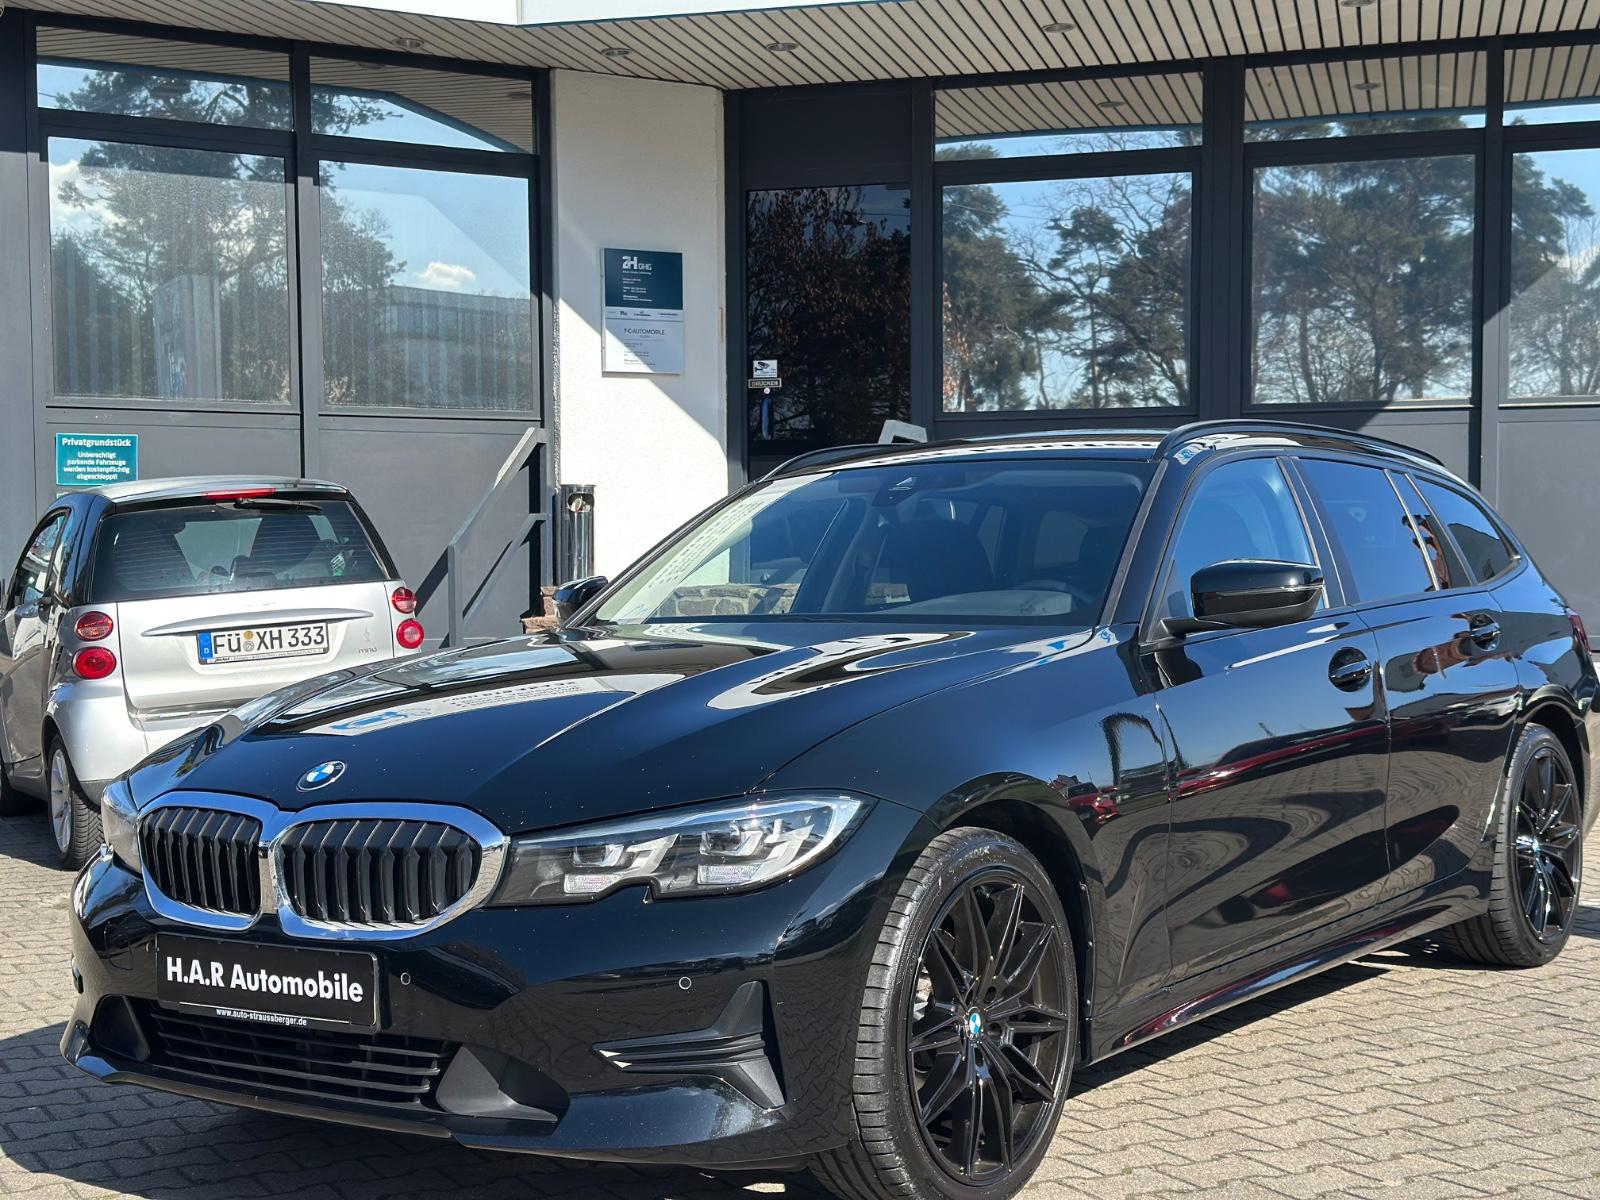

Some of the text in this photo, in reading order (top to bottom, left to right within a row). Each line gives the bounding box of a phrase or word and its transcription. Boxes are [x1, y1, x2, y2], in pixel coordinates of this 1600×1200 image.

[62, 438, 131, 447] Privatgrundstück
[86, 467, 130, 475] kostenpflichtig
[213, 633, 241, 655] FÜ
[257, 629, 284, 651] XH
[287, 626, 325, 648] 333
[166, 956, 364, 1002] H.A.R Automobile
[216, 1008, 307, 1026] www.auto-straussberger.de
